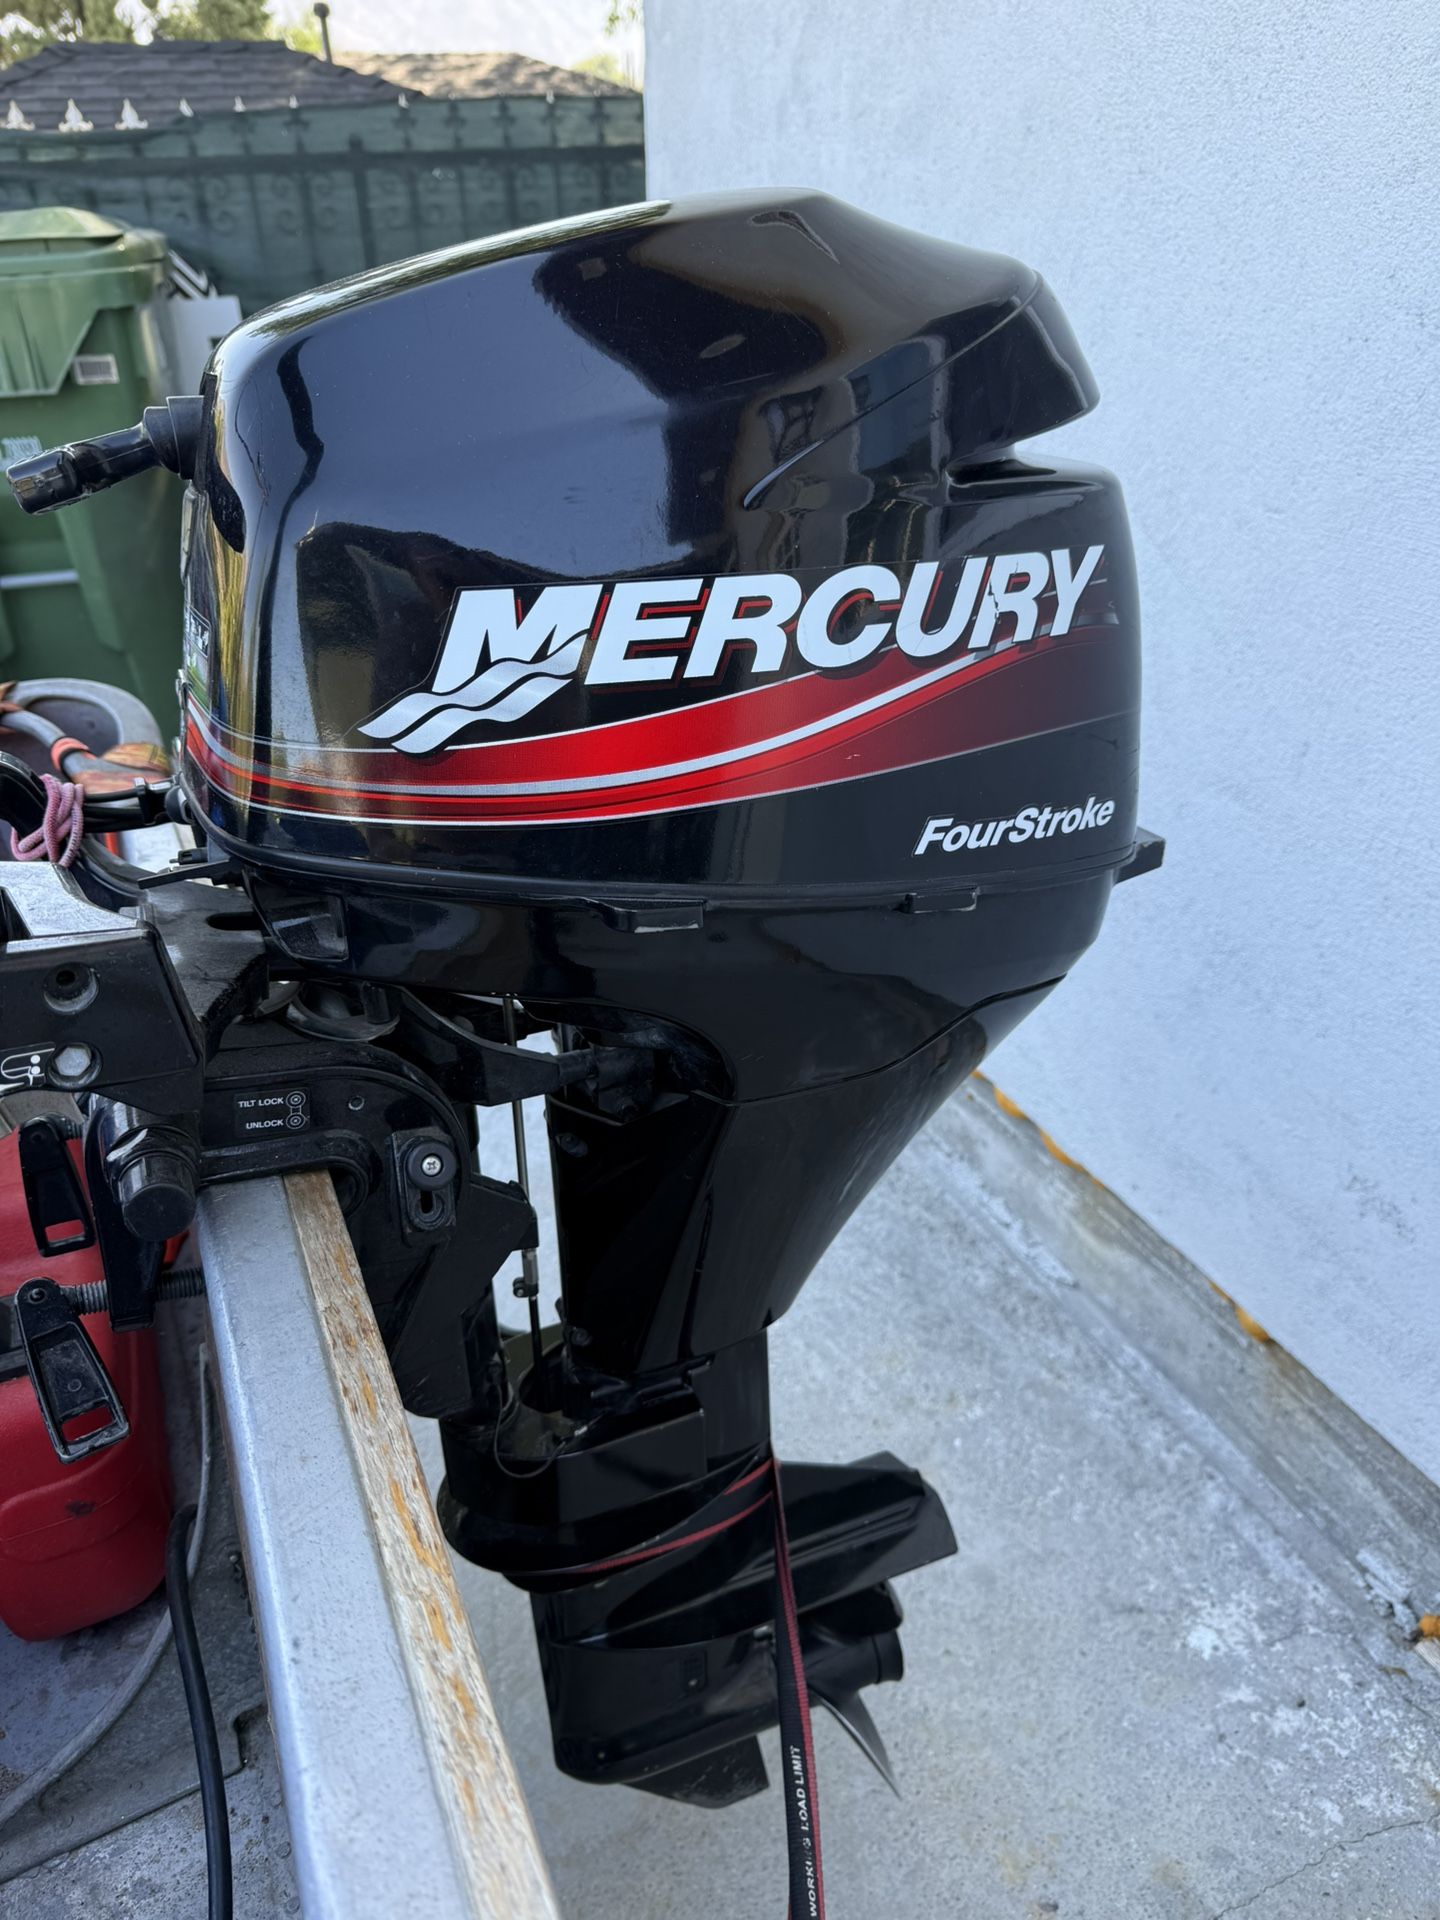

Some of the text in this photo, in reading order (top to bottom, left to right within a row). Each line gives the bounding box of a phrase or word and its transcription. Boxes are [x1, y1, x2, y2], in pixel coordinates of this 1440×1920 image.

[431, 545, 1105, 693] MERCURY
[914, 796, 1115, 855] FourStroke
[238, 1097, 284, 1108] TILT LOCK
[246, 1119, 284, 1129] UNLOCK
[790, 1745, 804, 1785] LIMIT
[796, 1788, 809, 1831] LOAD
